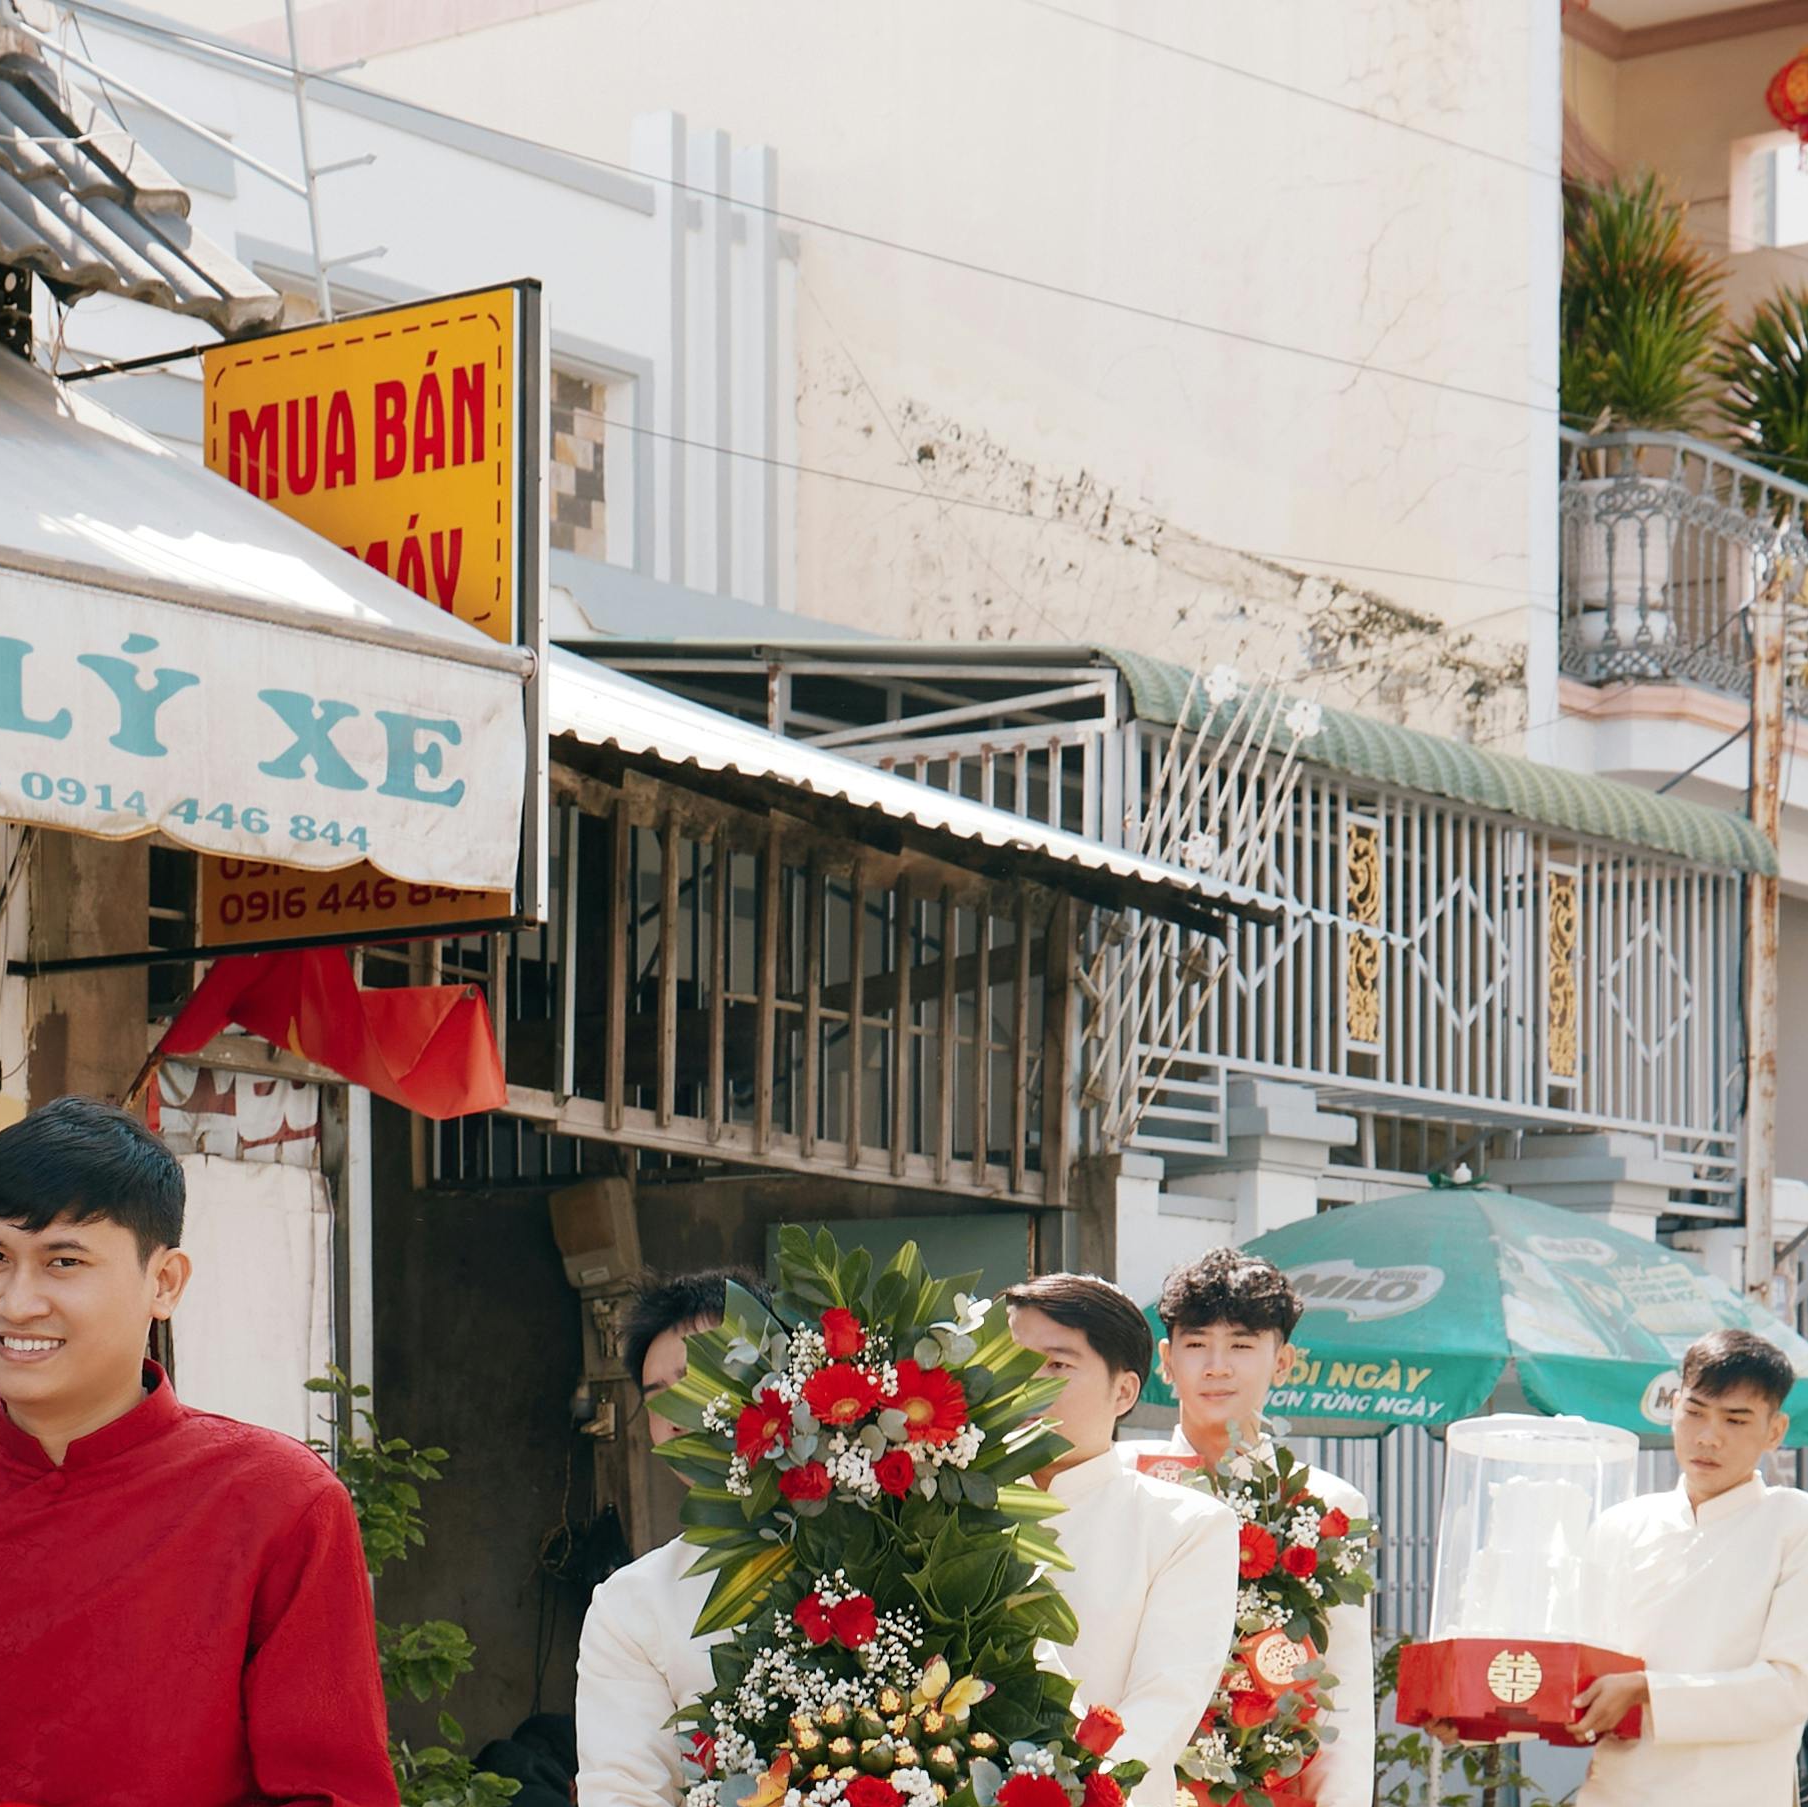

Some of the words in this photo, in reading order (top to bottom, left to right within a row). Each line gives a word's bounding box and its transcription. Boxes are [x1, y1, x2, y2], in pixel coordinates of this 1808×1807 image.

[228, 388, 358, 500] MUA
[375, 350, 487, 481] BÁN
[258, 688, 467, 809] XE
[20, 769, 150, 819] 0914
[168, 797, 271, 838] 446
[288, 814, 372, 854] 844
[219, 886, 308, 926] 0916
[316, 878, 397, 915] 446
[1293, 1273, 1420, 1302] MILO
[1325, 1358, 1433, 1393] NGÀY
[1309, 1388, 1373, 1413] TỪNG
[1373, 1396, 1446, 1419] NGÀY
